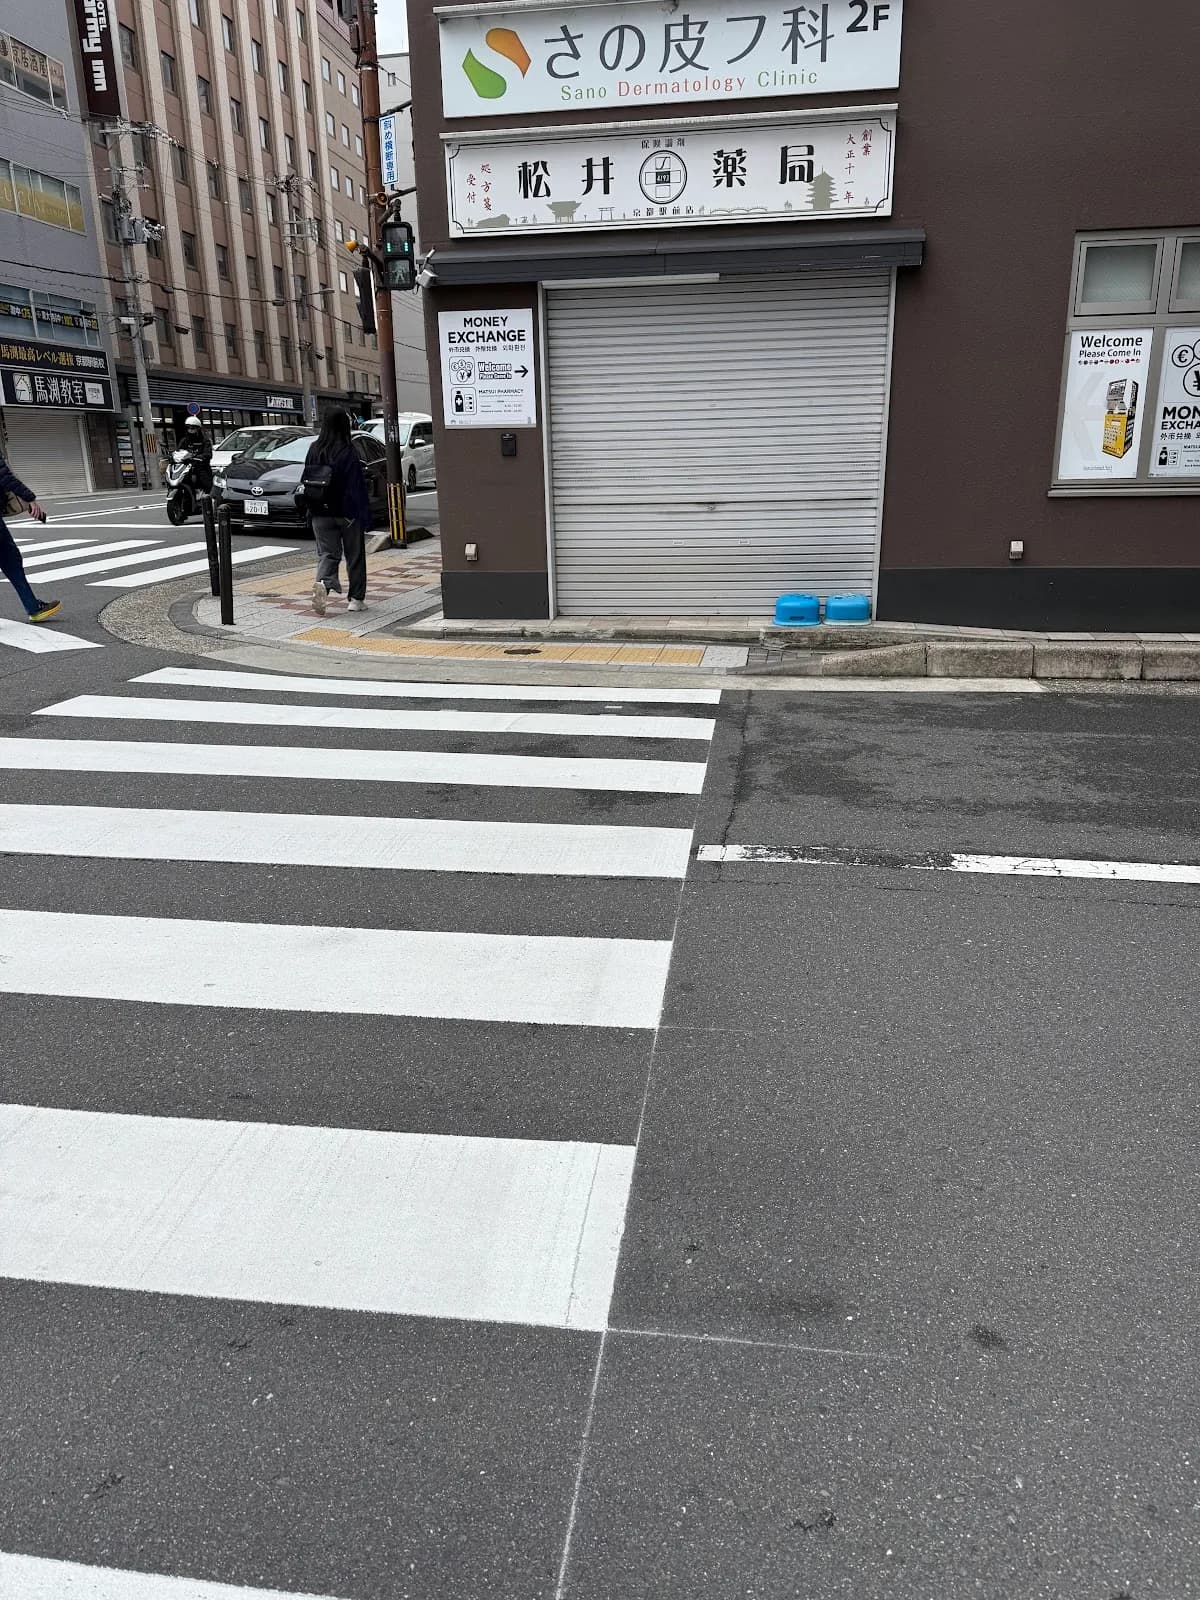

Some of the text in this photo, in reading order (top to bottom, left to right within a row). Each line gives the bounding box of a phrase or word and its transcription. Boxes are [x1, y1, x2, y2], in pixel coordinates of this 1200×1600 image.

[97, 0, 107, 31] OTEL
[845, 0, 890, 33] 2F
[544, 4, 834, 80] さの皮フ科
[92, 60, 107, 91] inn
[561, 69, 817, 101] Sano Dermatology Clinic
[861, 128, 872, 157] 創業
[517, 144, 815, 200] 松井 薬局
[844, 133, 856, 204] 大正十一年
[466, 173, 476, 204] 受付
[480, 163, 492, 211] 処方箋
[448, 330, 526, 343] EXCHANGE
[463, 316, 508, 327] MONEY
[1079, 348, 1141, 358] Please Come In
[1080, 335, 1143, 348] Welcome
[478, 362, 512, 372] Welcome
